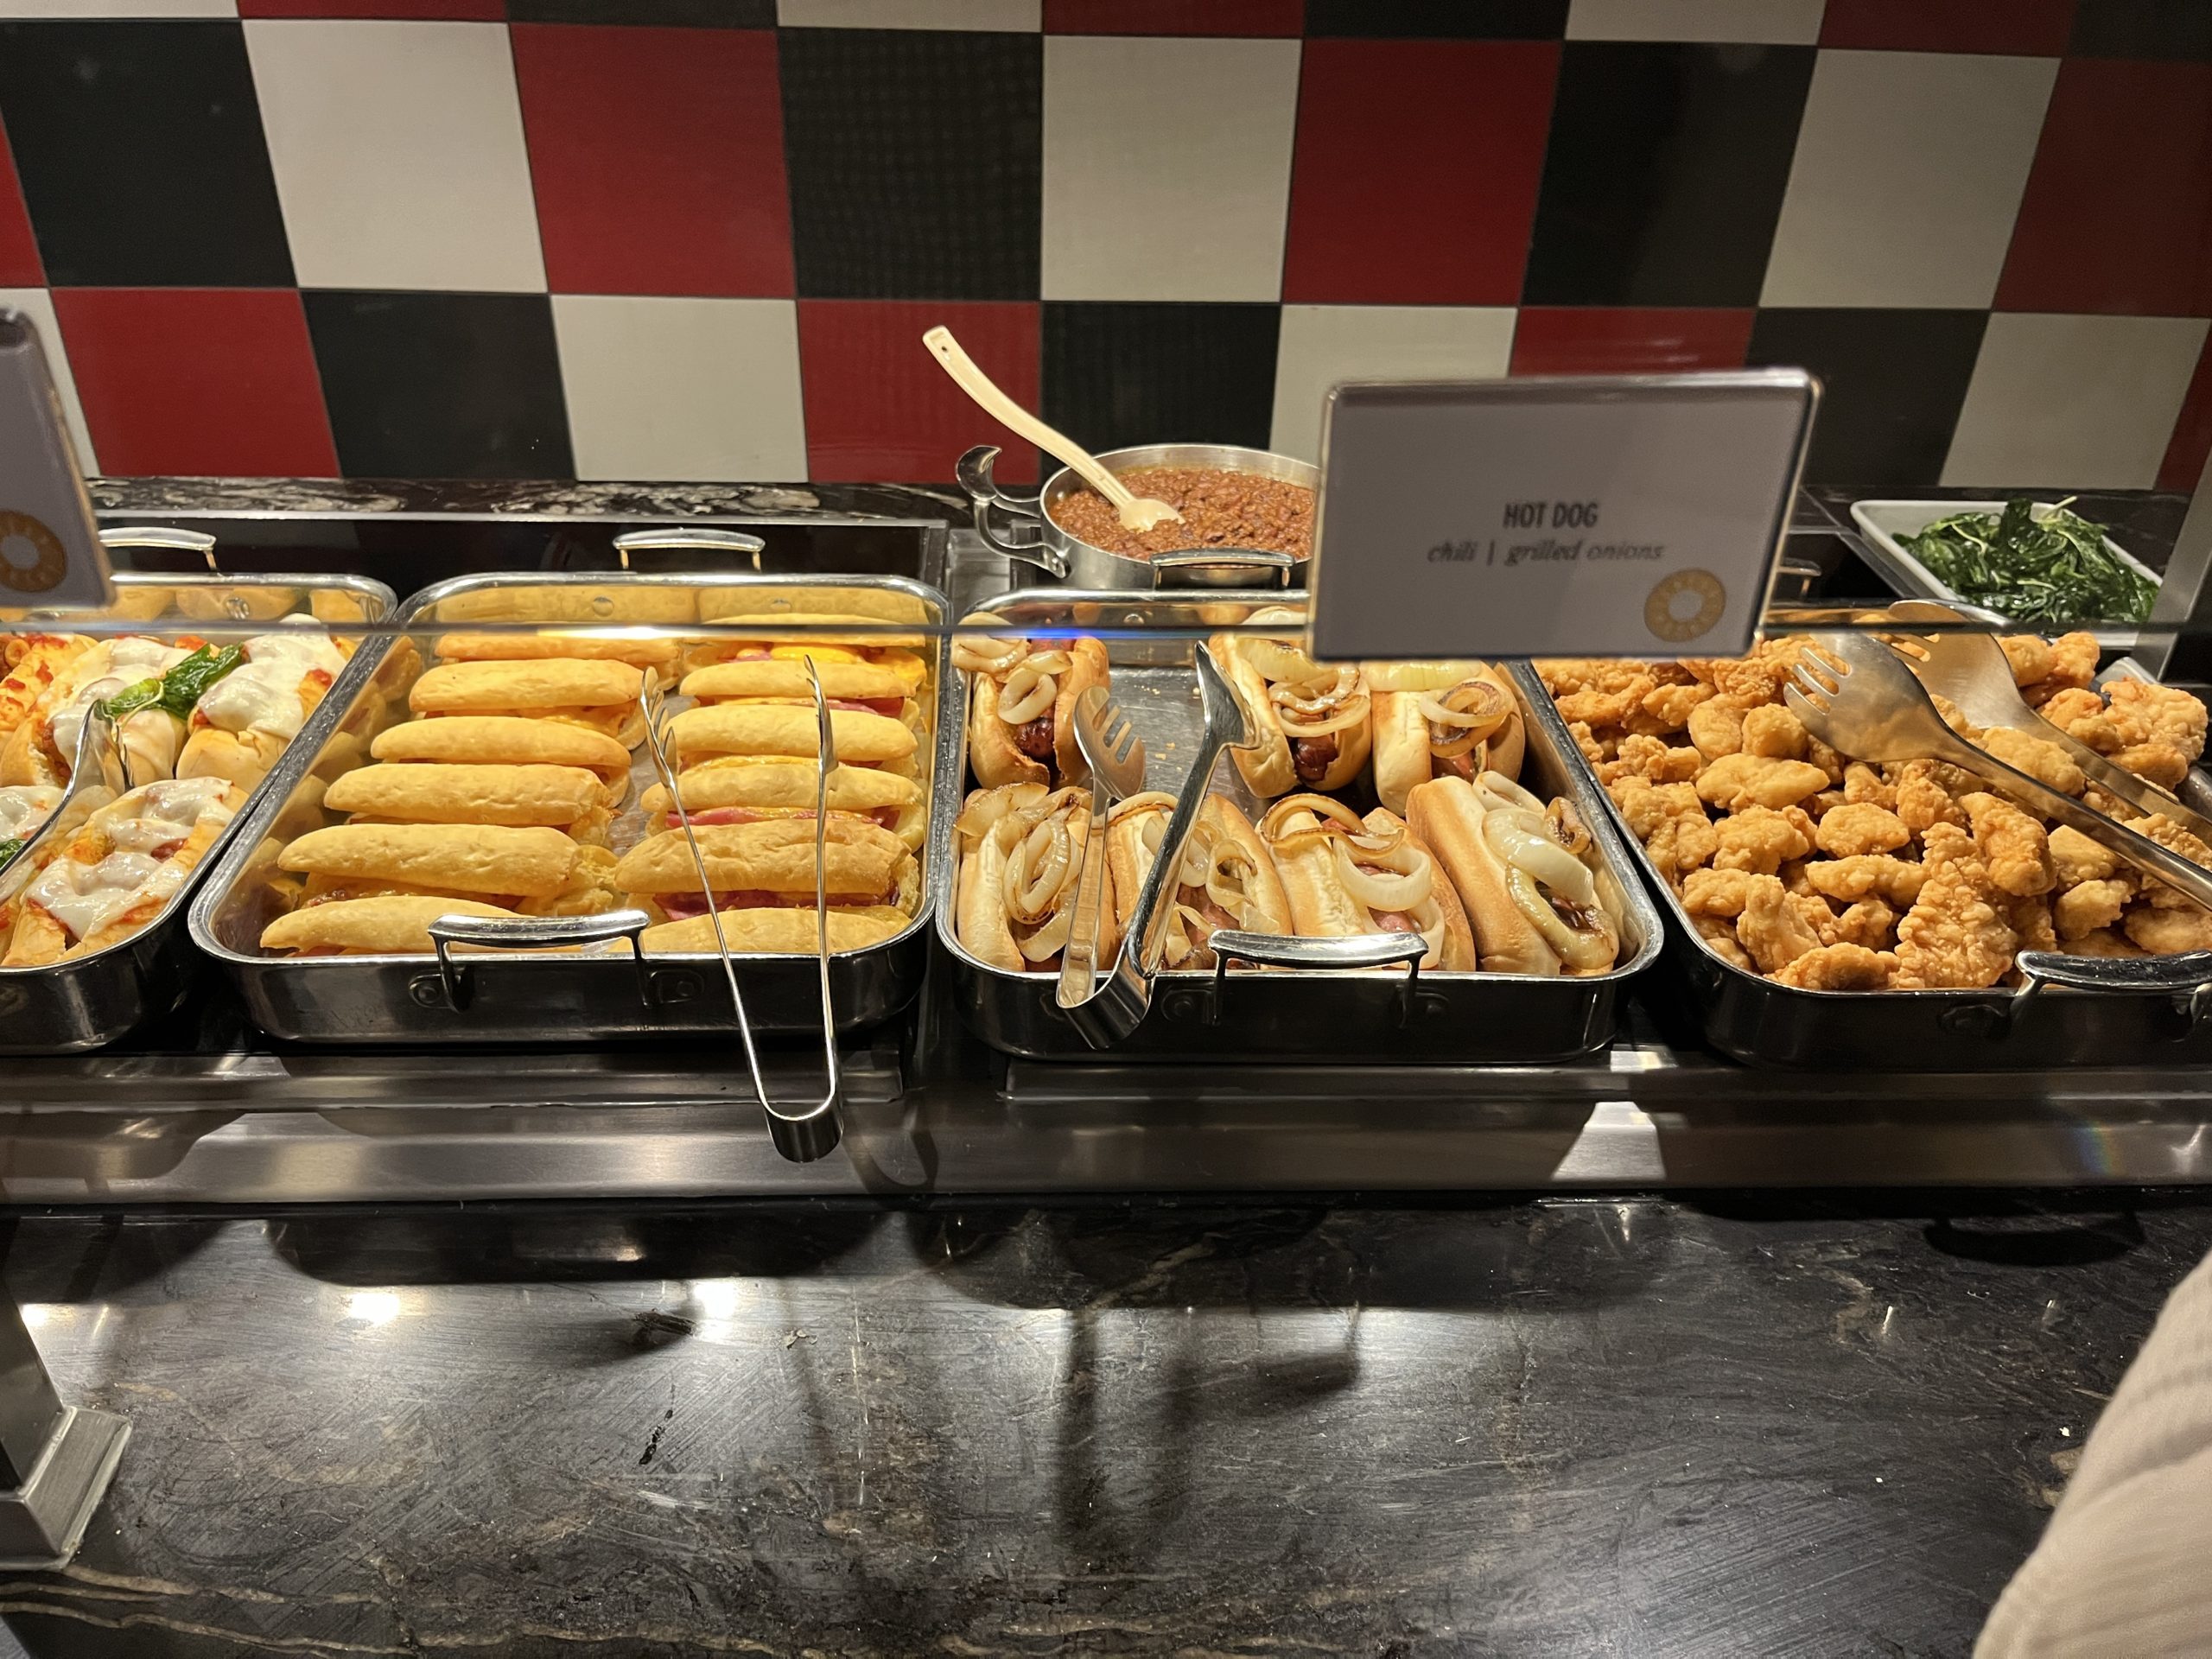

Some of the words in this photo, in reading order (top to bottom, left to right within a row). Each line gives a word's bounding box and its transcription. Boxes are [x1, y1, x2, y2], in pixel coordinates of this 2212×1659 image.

[1503, 502, 1547, 529] HOT
[1552, 502, 1599, 529] DOG
[1427, 541, 1478, 563] chili
[1504, 540, 1583, 566] grilled
[1586, 543, 1664, 560] onions
